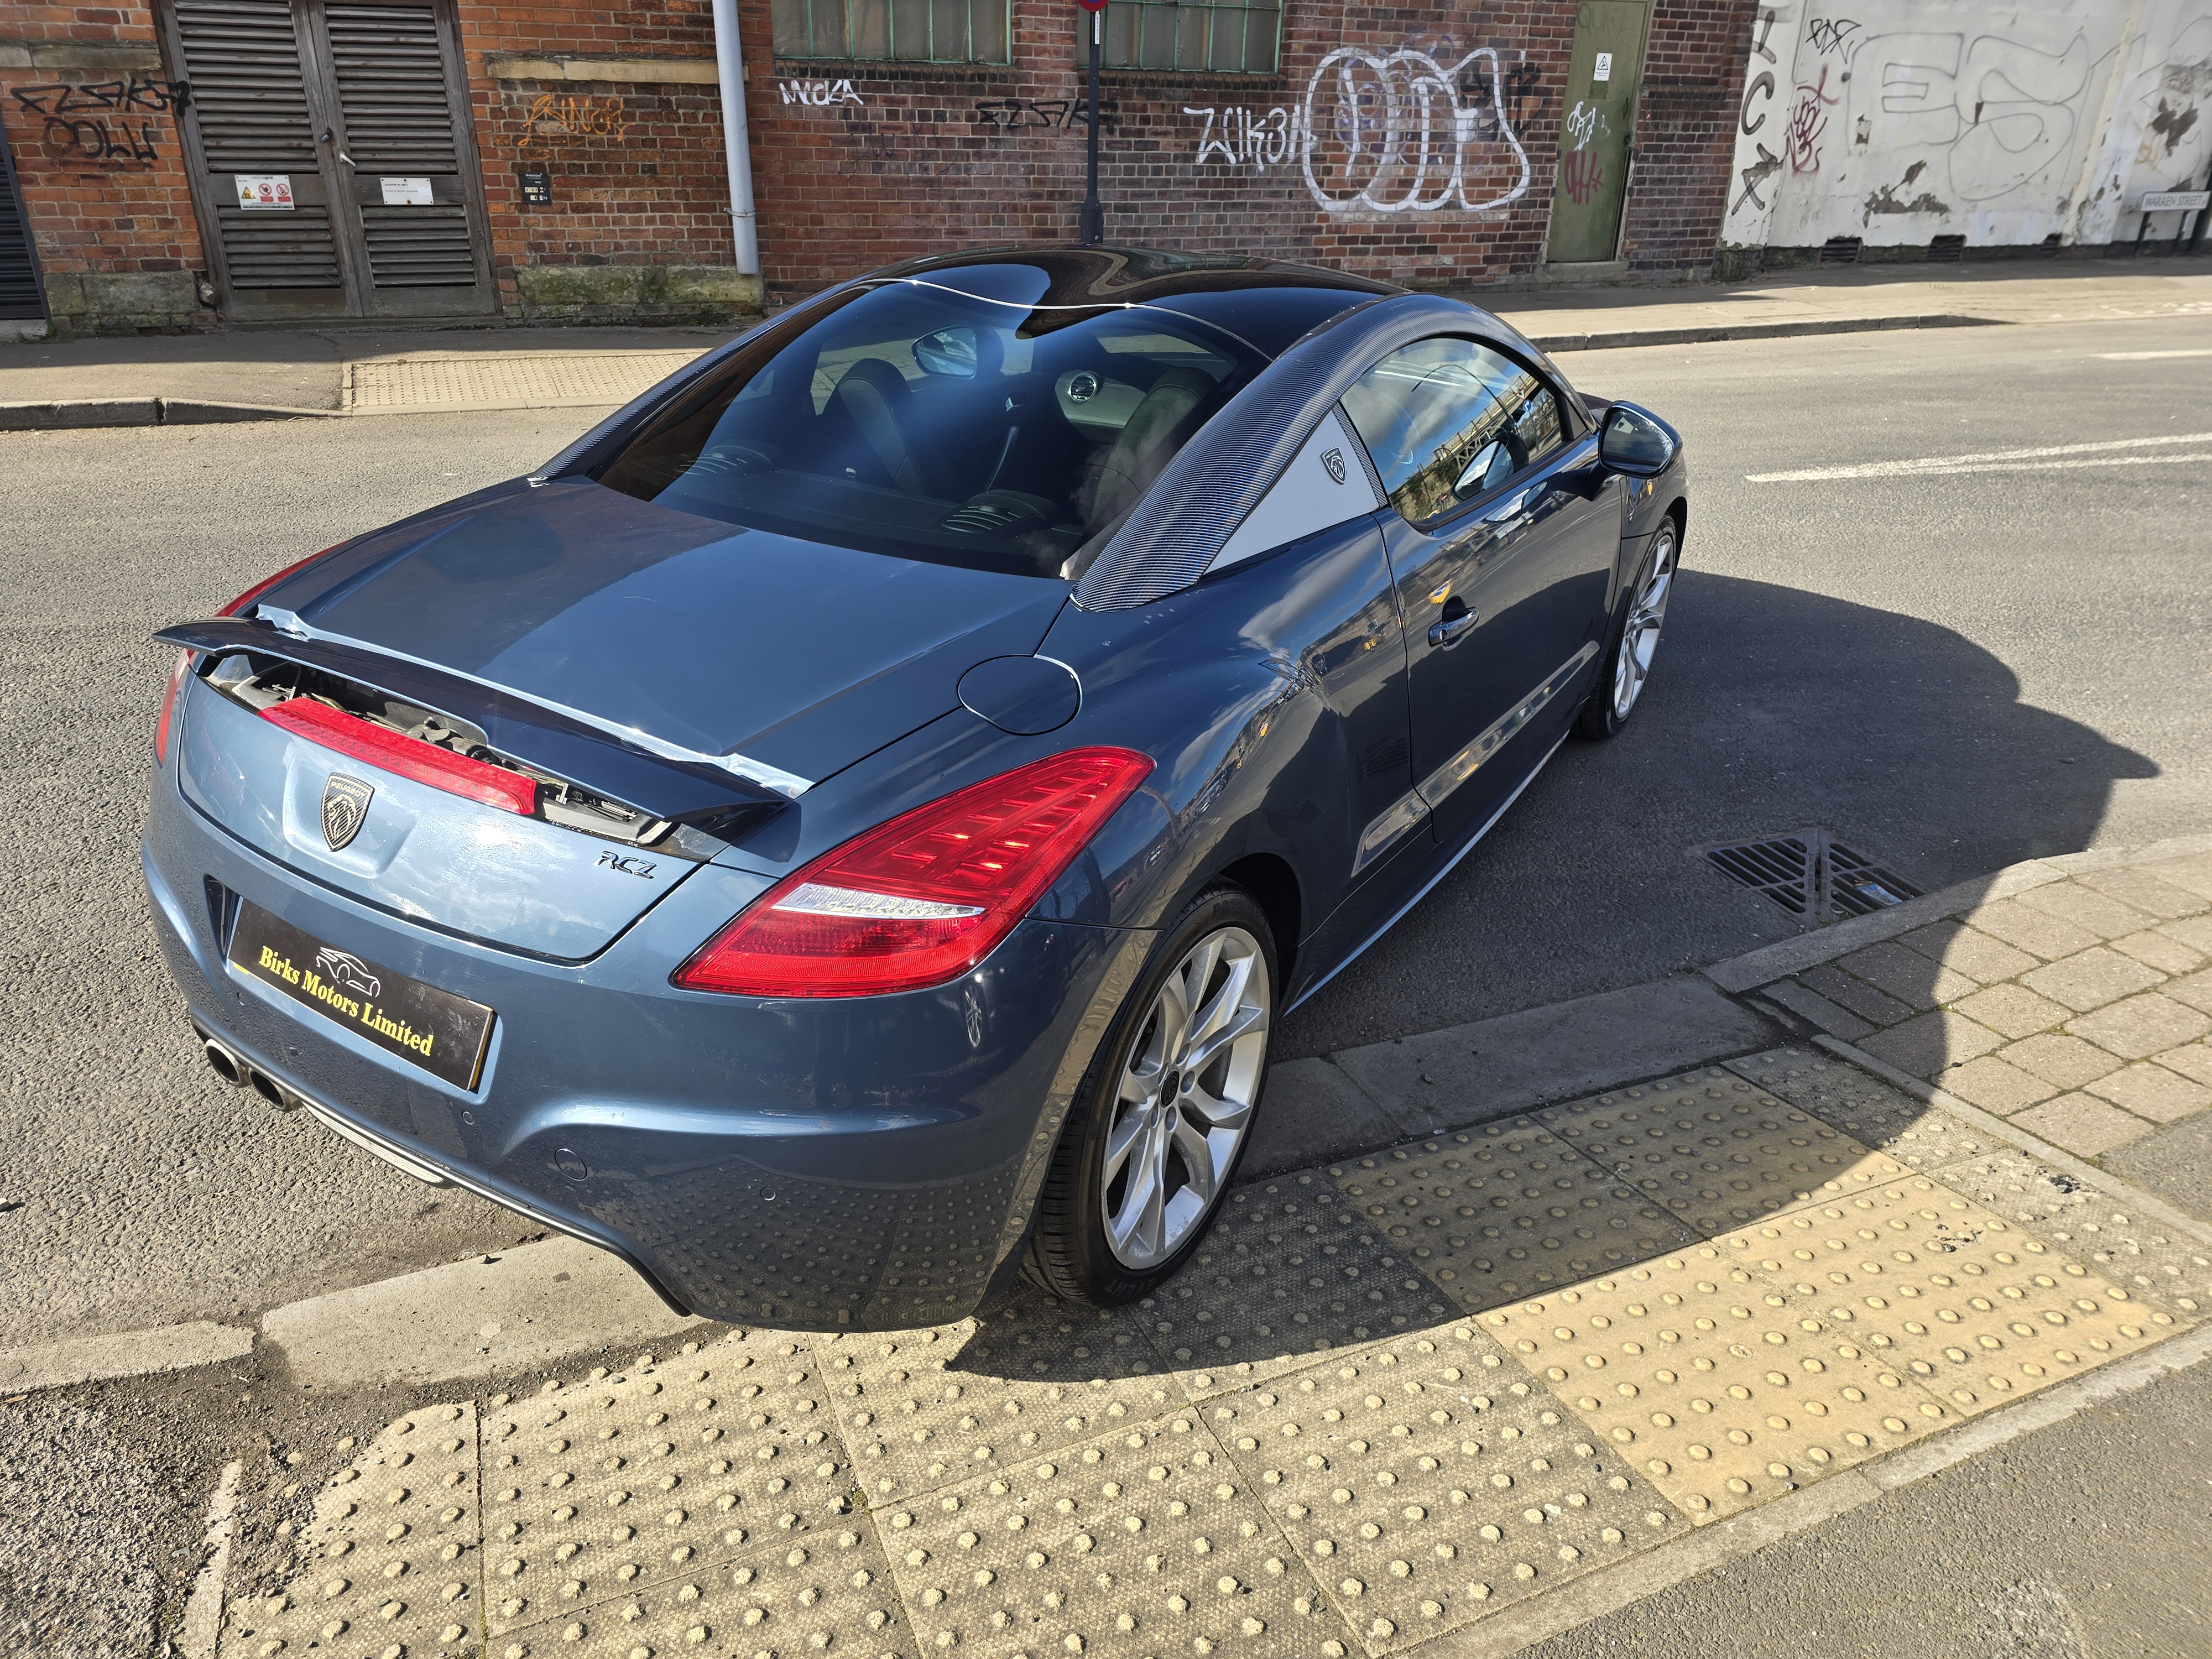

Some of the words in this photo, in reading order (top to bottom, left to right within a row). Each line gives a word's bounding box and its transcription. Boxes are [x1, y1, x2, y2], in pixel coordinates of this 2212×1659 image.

[2145, 195, 2177, 207] WARREN
[2177, 195, 2204, 206] STREET
[331, 781, 366, 799] PEUGEOT
[593, 850, 658, 879] RCZ
[259, 945, 300, 985] Birks
[301, 970, 359, 1017] Motors
[361, 1002, 434, 1056] Limited
[1103, 1276, 1157, 1300] EVENT
